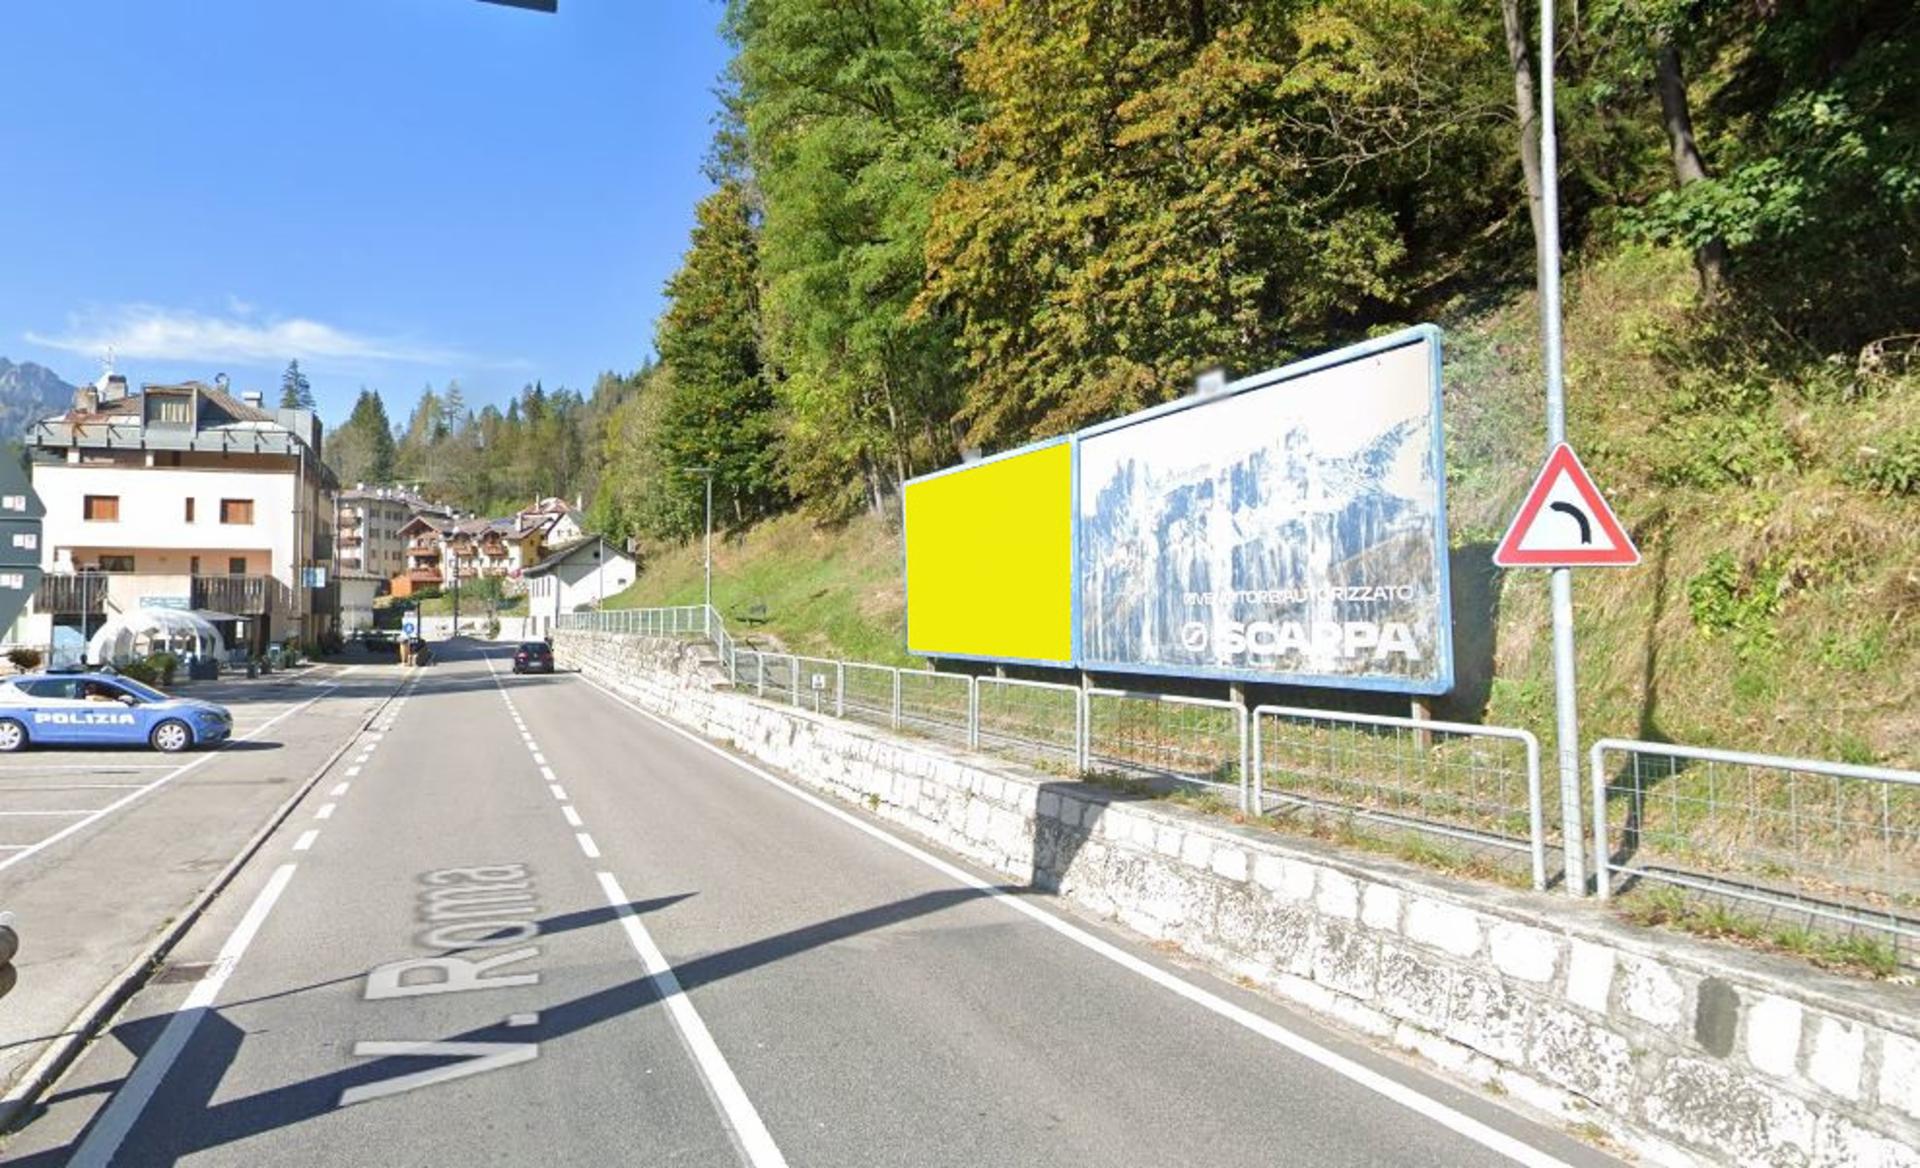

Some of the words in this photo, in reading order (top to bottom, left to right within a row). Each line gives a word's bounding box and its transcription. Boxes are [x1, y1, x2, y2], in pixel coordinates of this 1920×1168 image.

[1282, 585, 1414, 604] AUTORIZZATO
[1214, 620, 1421, 661] SCARPA
[34, 712, 135, 725] POLIZIA
[364, 863, 540, 999] Roma
[338, 1013, 540, 1107] V.
